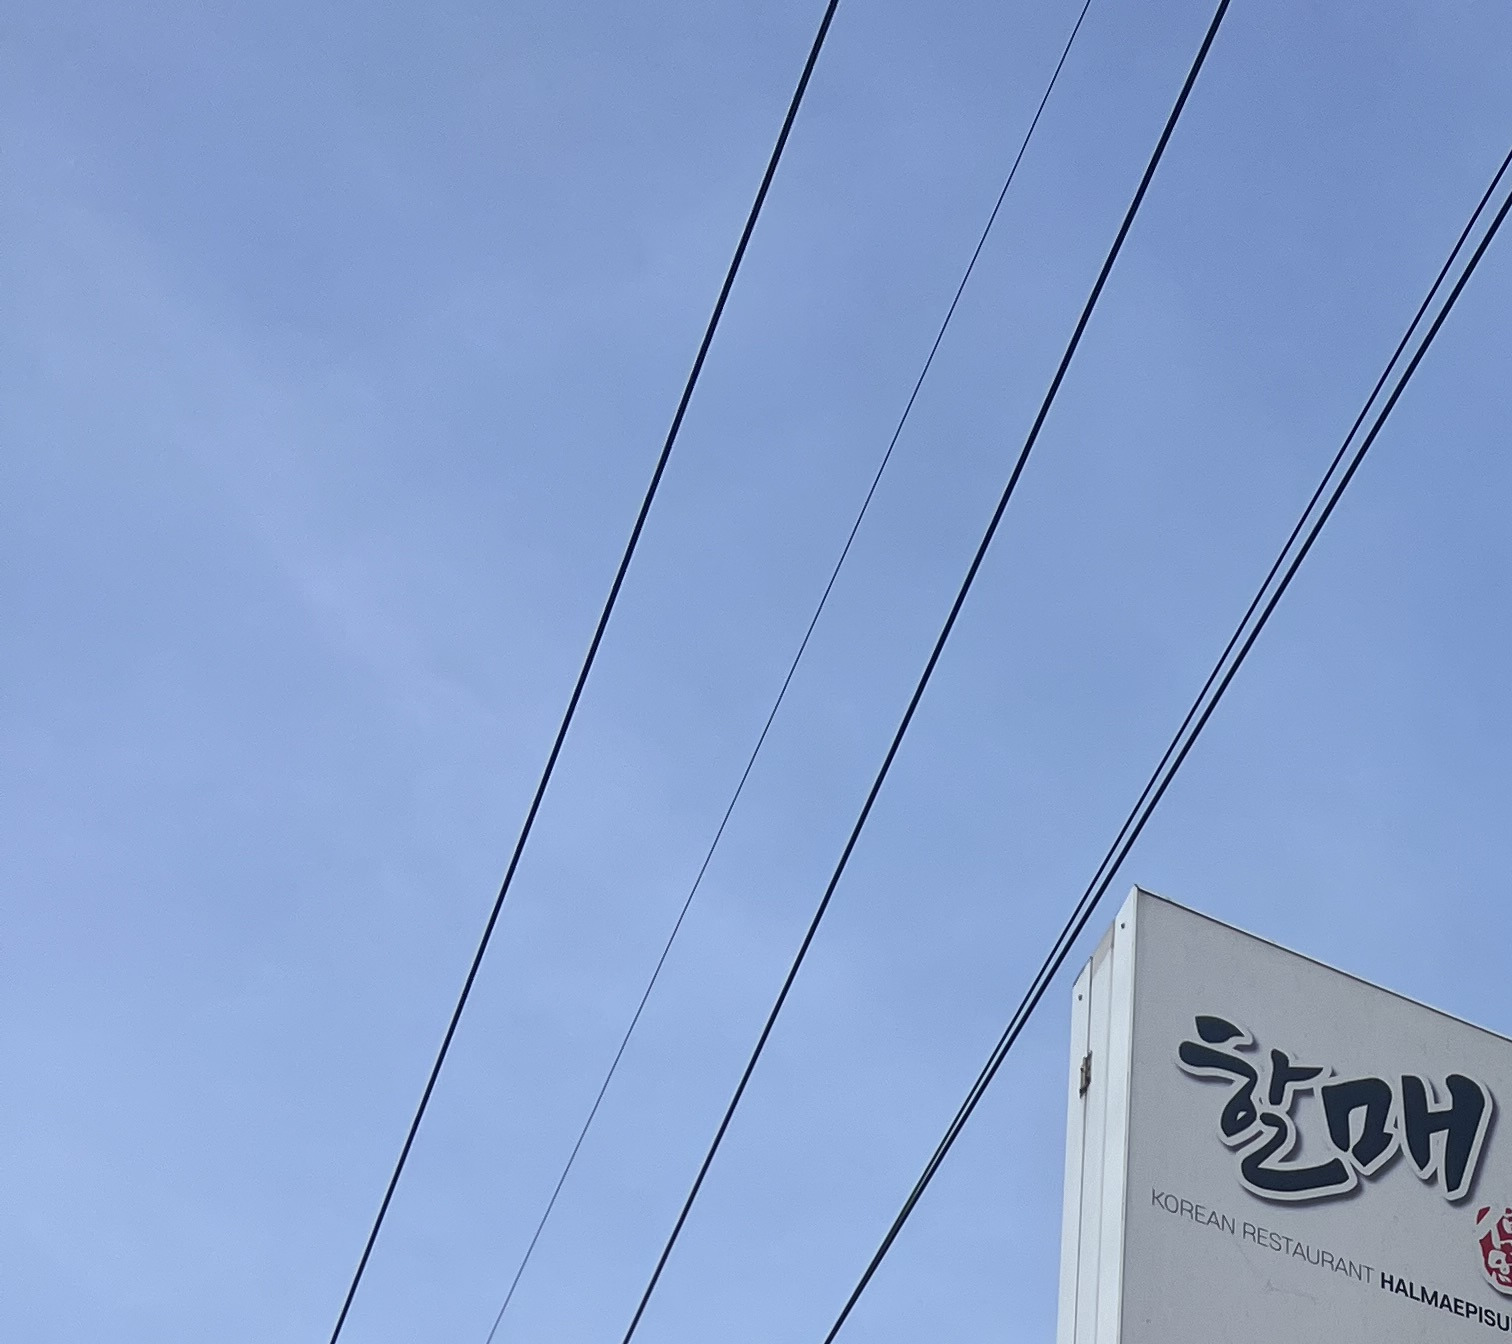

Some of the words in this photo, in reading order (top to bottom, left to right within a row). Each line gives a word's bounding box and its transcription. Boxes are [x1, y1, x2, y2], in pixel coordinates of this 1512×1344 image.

[1177, 1014, 1487, 1196] 할매
[1150, 1187, 1236, 1236] KOREAN
[1242, 1221, 1376, 1285] RESTAURANT
